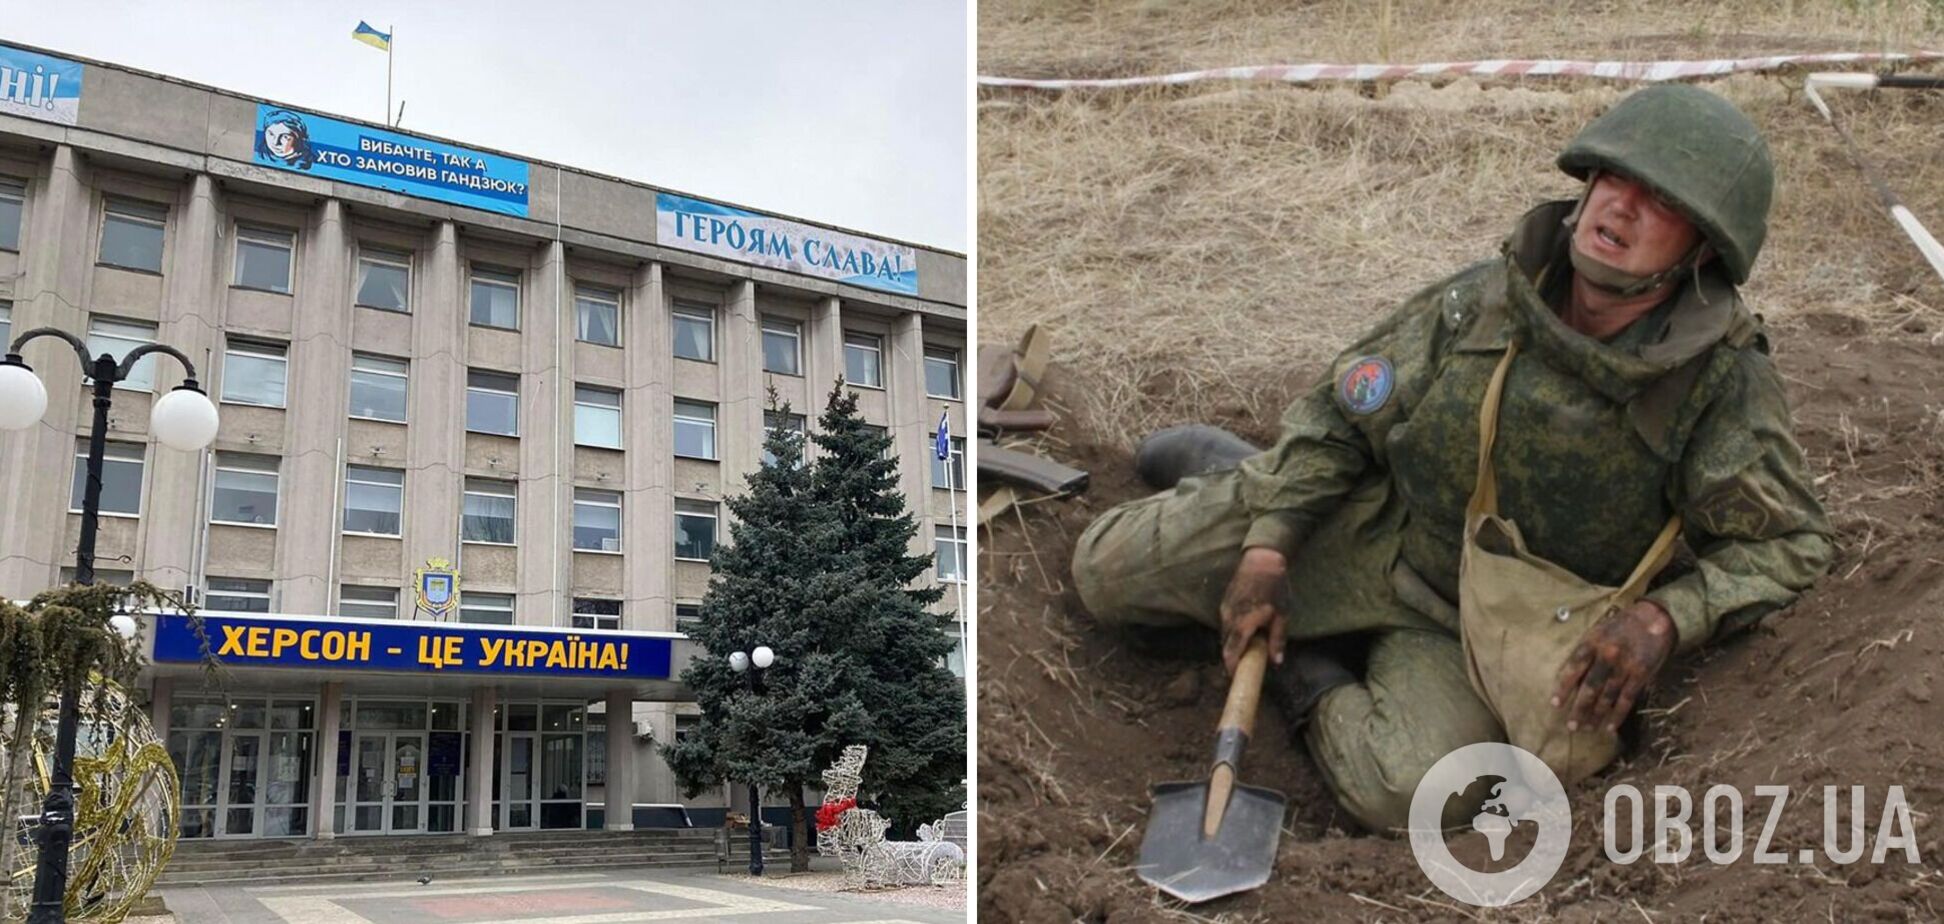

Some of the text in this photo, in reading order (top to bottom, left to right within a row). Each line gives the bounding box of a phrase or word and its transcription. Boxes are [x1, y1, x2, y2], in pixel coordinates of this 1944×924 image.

[316, 149, 526, 195] ХТО ЗАМОВИВ ГАНДЗЮК?
[361, 138, 488, 171] ВИБАЧТЕ, ТАК А
[674, 211, 902, 283] ГЕРОЯМ СЛАВА!
[217, 624, 372, 662] ХЕРСОН
[418, 635, 462, 669] ЦЕ
[478, 635, 630, 671] УКРАЇНА!
